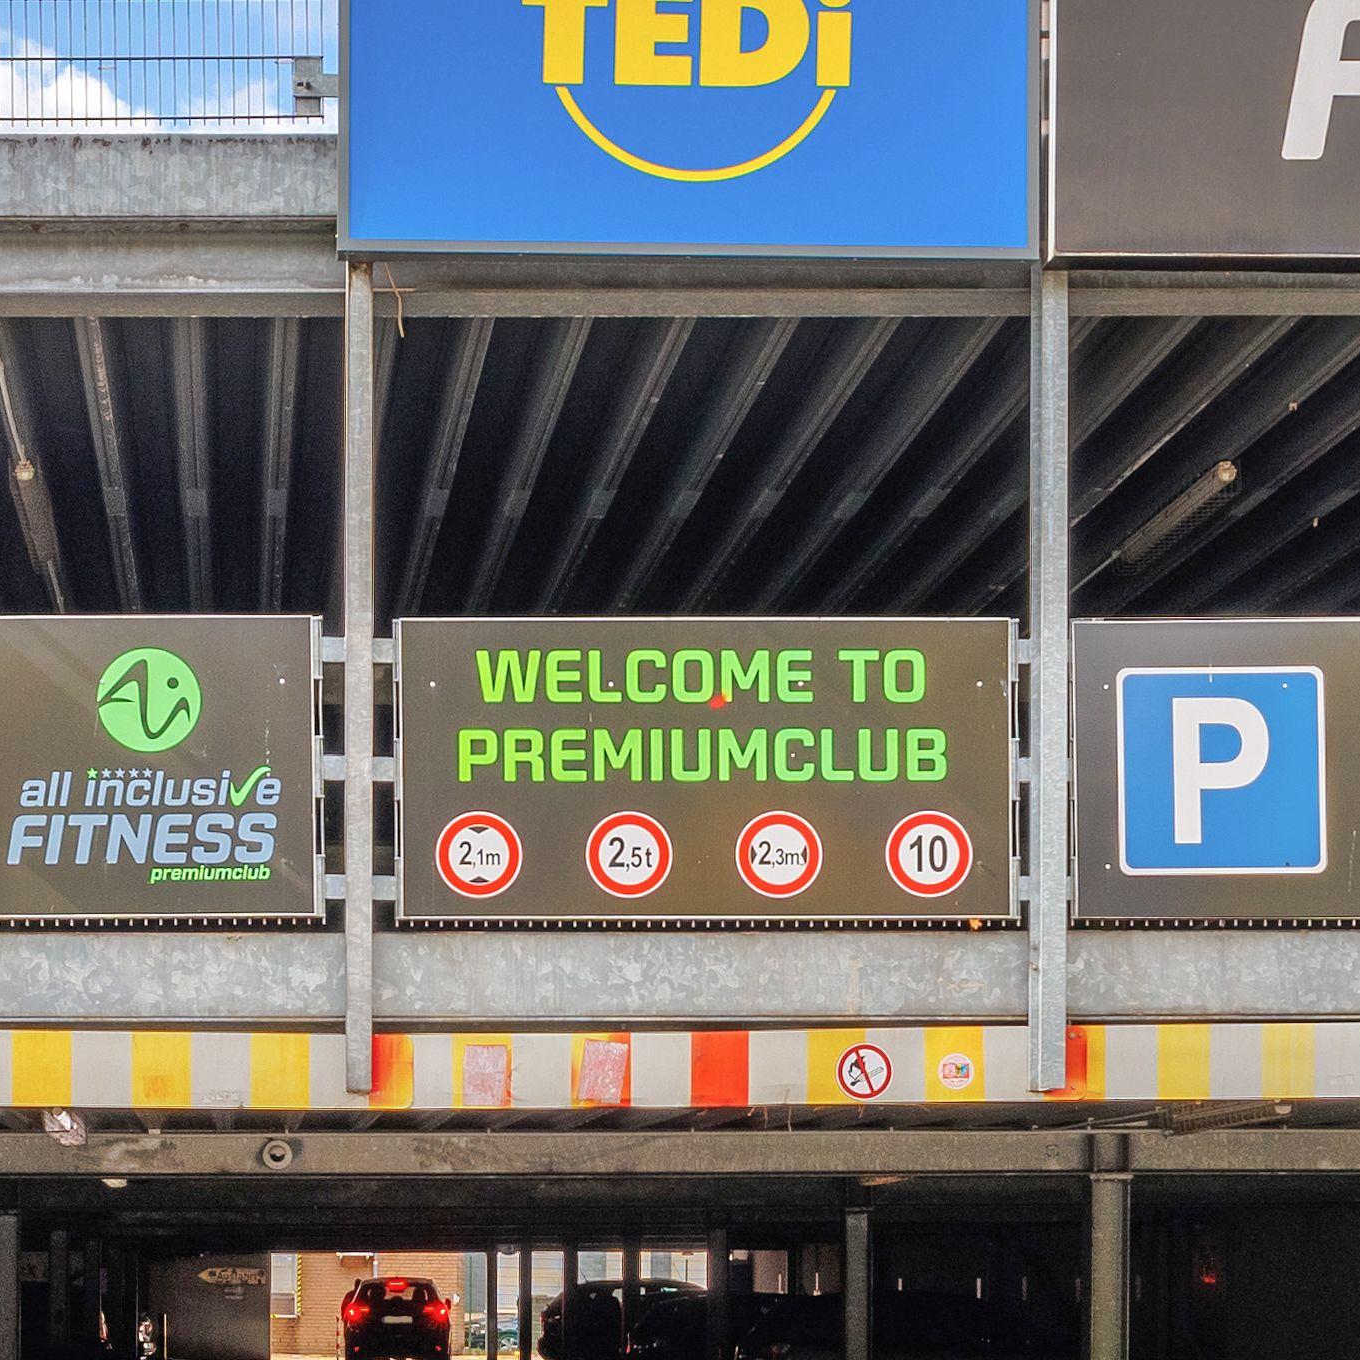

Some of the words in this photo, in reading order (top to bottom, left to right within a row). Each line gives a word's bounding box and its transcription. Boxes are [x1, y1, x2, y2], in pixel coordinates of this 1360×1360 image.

[521, 0, 853, 87] TEDi
[475, 649, 814, 704] WELCOME
[837, 649, 926, 704] TO
[457, 728, 949, 783] PREMIUMCLUB
[1172, 697, 1269, 845] P
[20, 771, 72, 807] all
[85, 766, 281, 808] inclusive
[7, 813, 278, 865] FITNESS
[909, 835, 949, 873] 10
[149, 864, 271, 884] premiumclub
